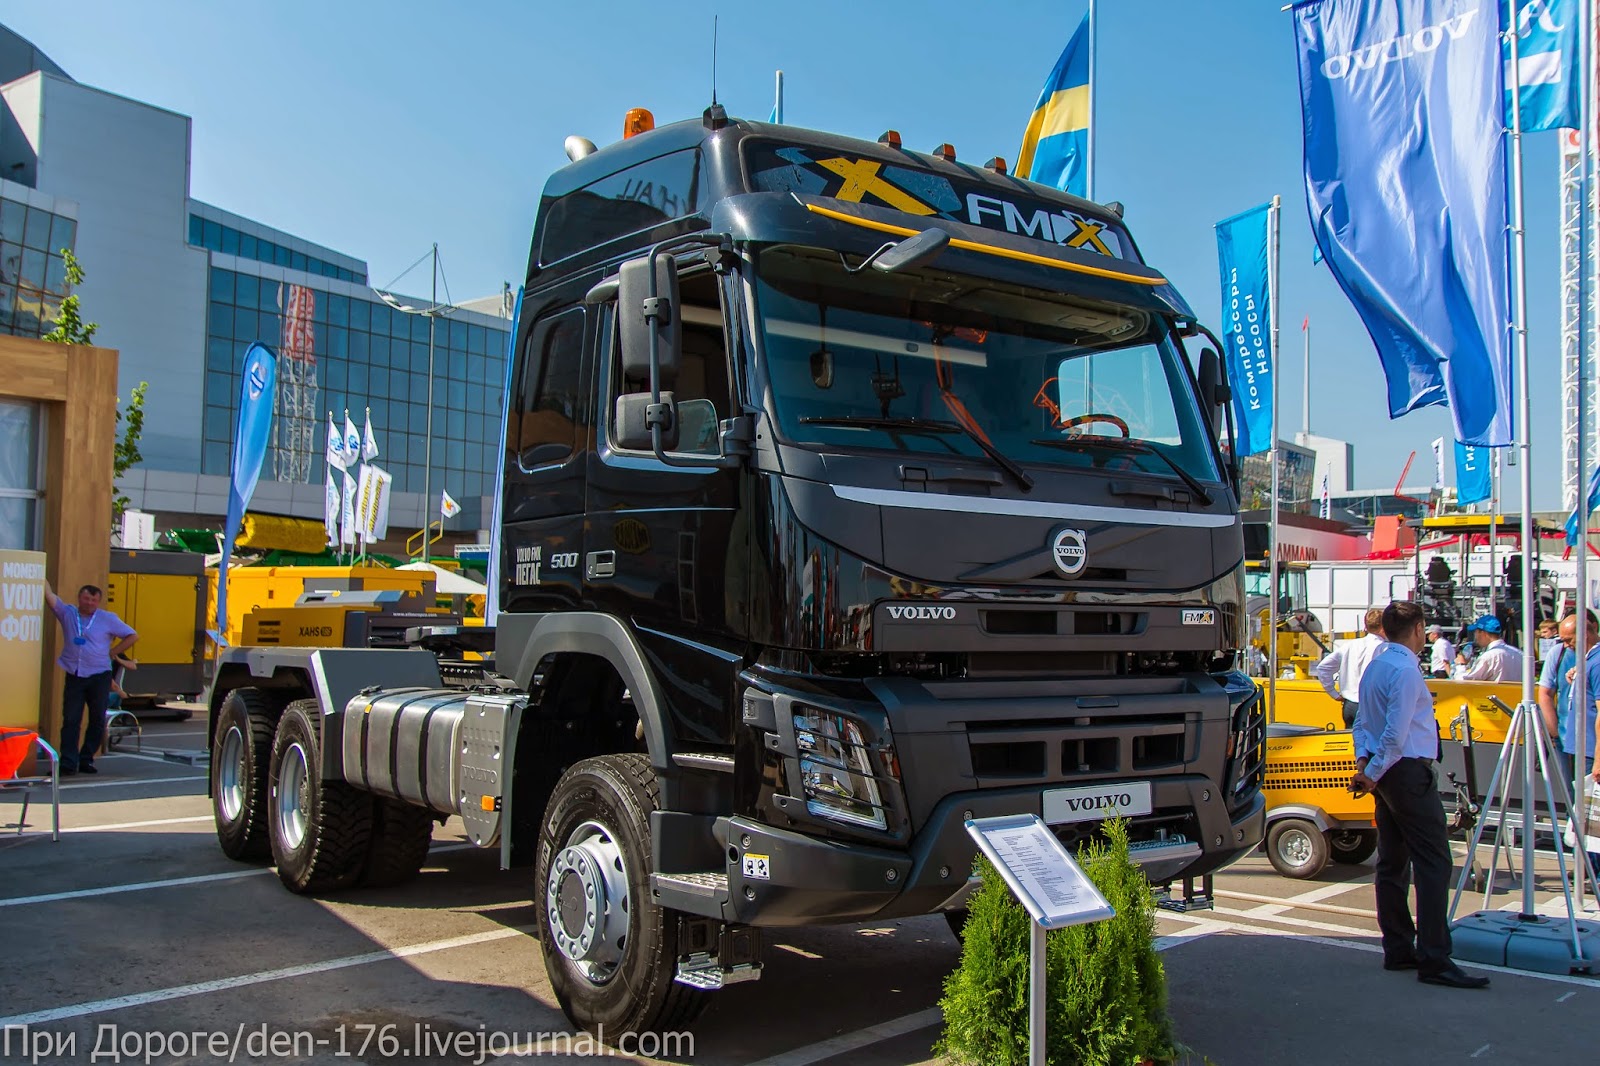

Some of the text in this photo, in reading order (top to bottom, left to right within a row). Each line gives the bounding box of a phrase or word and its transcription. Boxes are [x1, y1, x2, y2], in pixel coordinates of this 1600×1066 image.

[966, 193, 1123, 260] FMX
[1231, 267, 1261, 410] Компрессоры
[1244, 294, 1269, 375] Насосы
[1056, 547, 1084, 555] VOLVO
[1277, 543, 1318, 561] AMMANN
[550, 552, 579, 569] 500
[516, 562, 541, 585] ПЕГАС
[886, 606, 956, 620] VOLVO
[1184, 611, 1213, 623] FMX
[299, 626, 320, 637] XAHS
[1066, 793, 1132, 812] VOLVO
